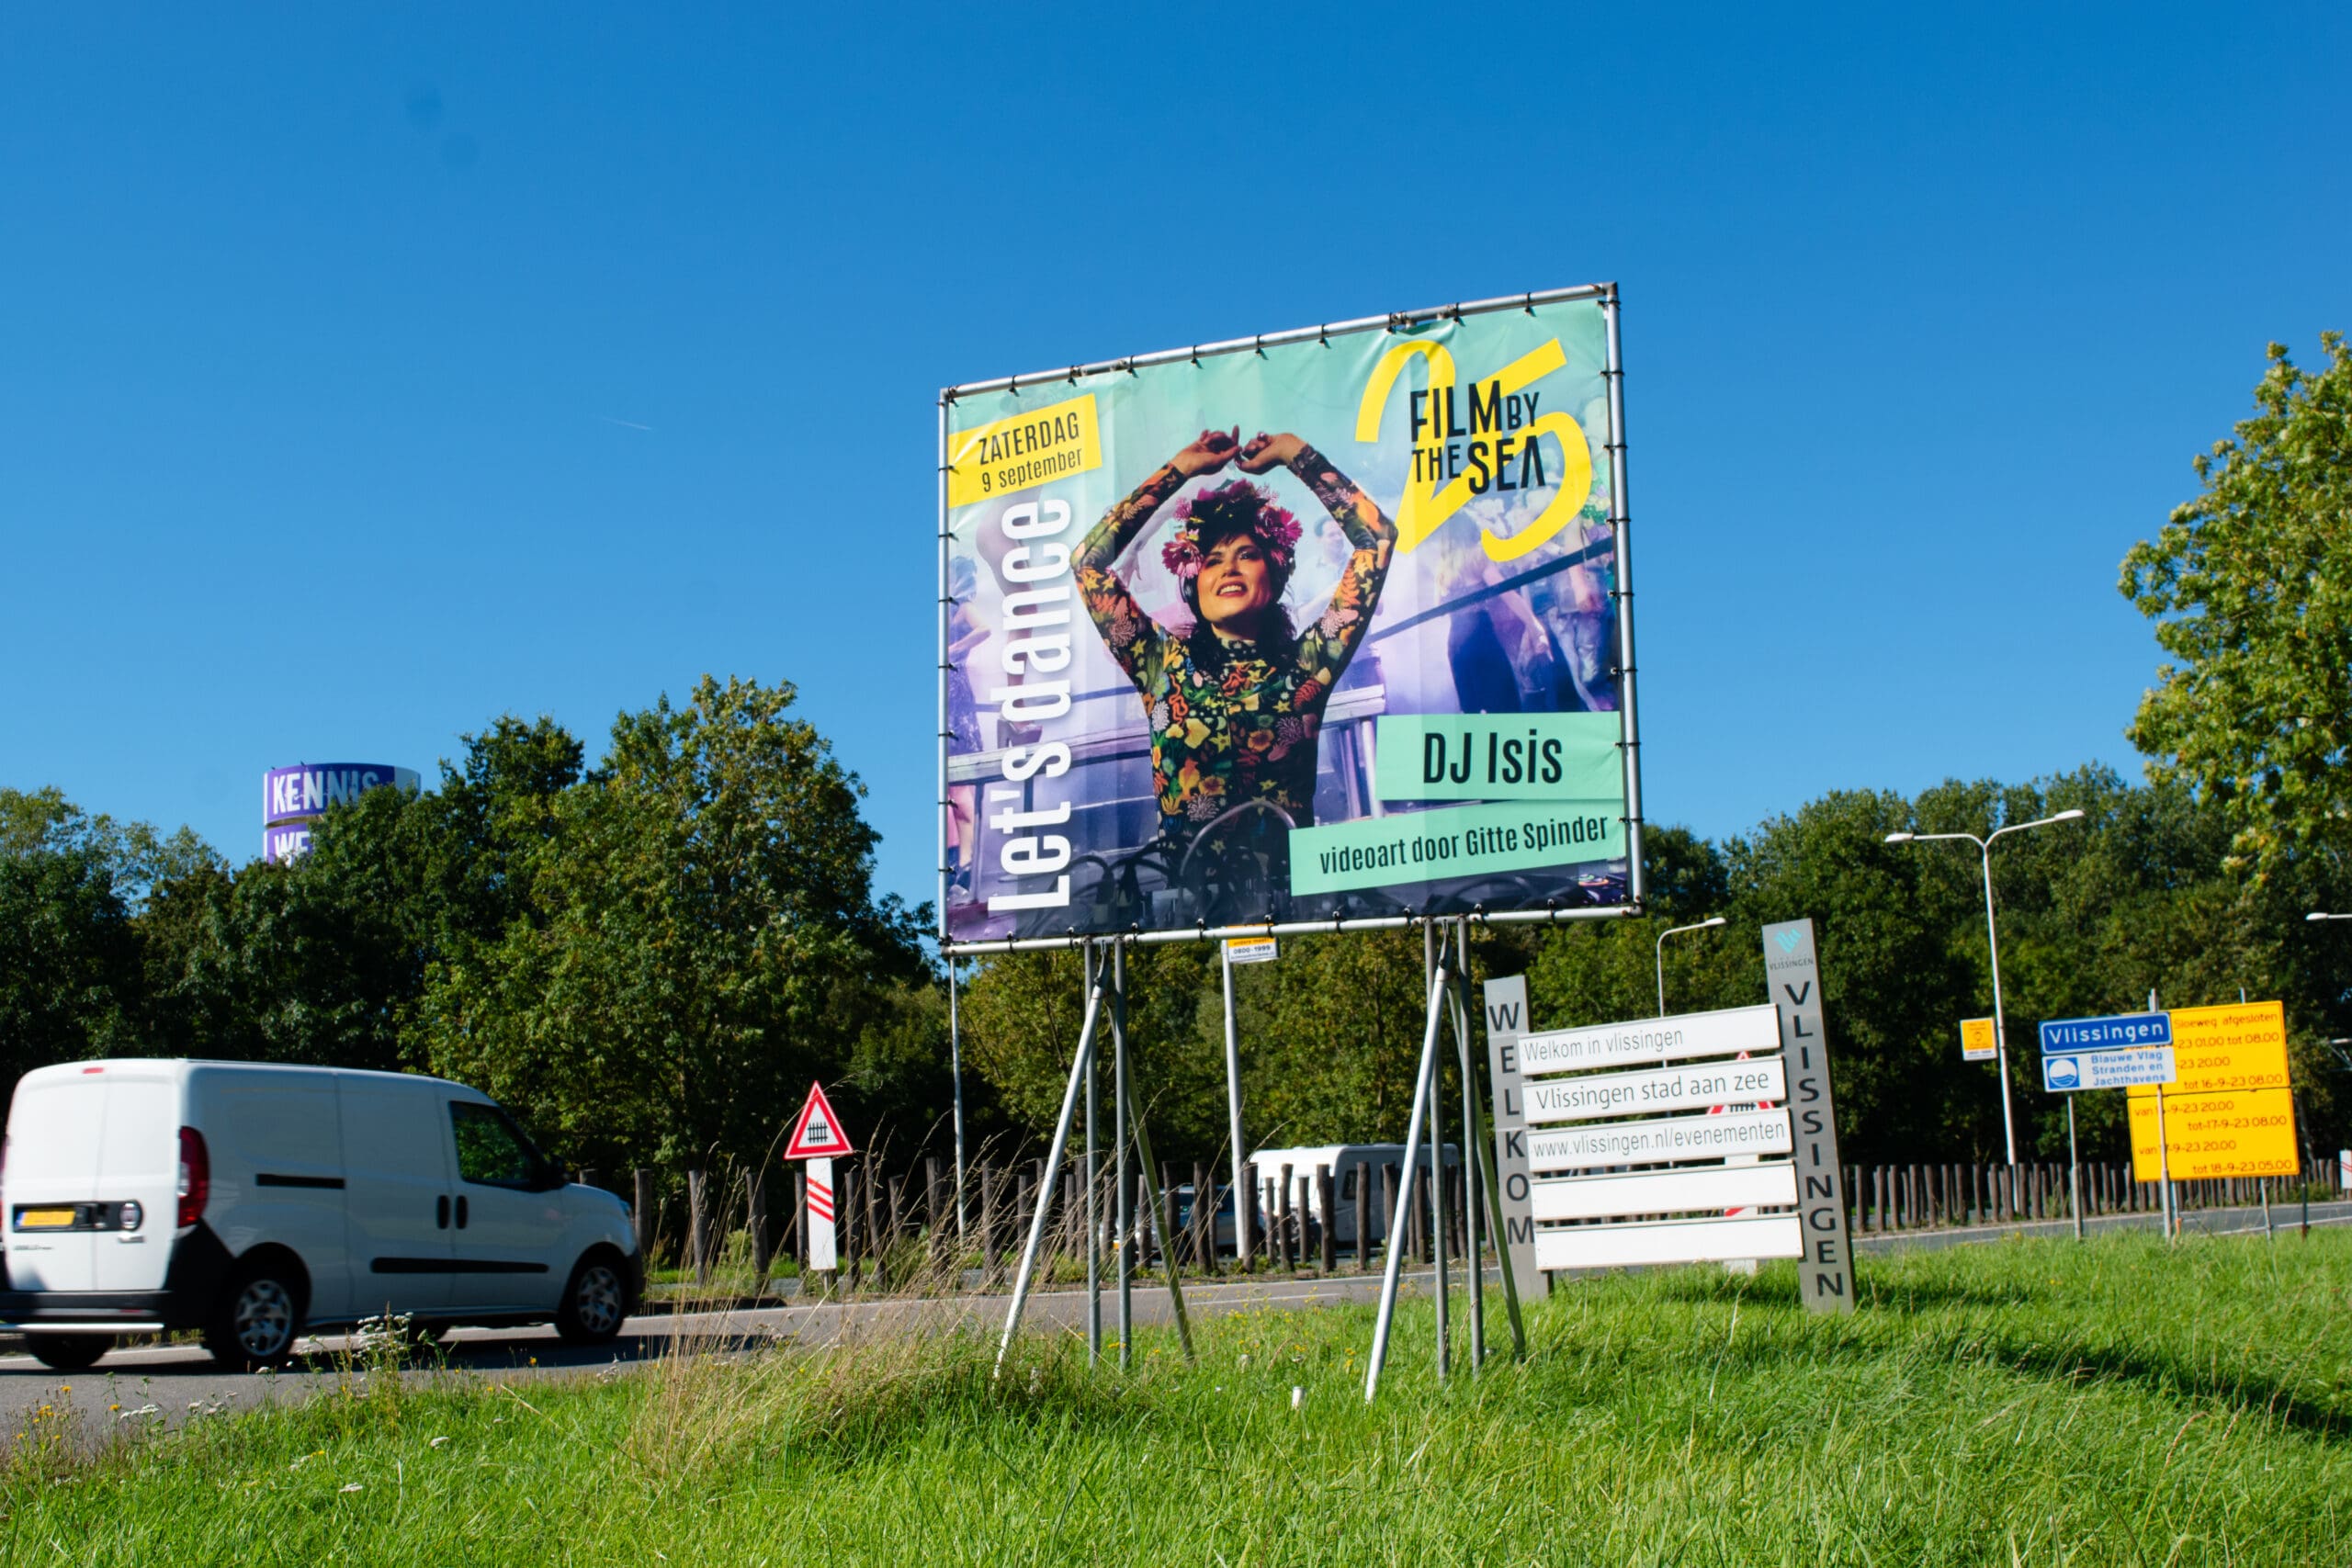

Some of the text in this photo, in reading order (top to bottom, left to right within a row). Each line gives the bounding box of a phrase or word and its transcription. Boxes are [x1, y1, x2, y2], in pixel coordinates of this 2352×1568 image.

[1410, 380, 1540, 442] FILM BY
[978, 412, 1080, 466] ZATERDAG
[1355, 339, 1592, 562] 25
[982, 448, 1082, 492] 9 september
[1412, 435, 1546, 495] THE SEA
[988, 497, 1071, 912] Let's dance
[1424, 729, 1563, 784] DJ Isis
[1320, 816, 1608, 874] videoart door Gitte Spinder
[2048, 1022, 2164, 1044] Vlissingen
[2222, 1012, 2278, 1027] afgesloten
[1524, 1029, 1684, 1062] Welkom in vlissingen
[2195, 1036, 2224, 1047] 01.00
[2227, 1035, 2242, 1044] tot
[2245, 1032, 2279, 1043] 08.00
[2091, 1051, 2163, 1065] Blauwe Vlag
[2092, 1062, 2163, 1075] Stranden en
[2198, 1056, 2231, 1068] 20.00
[1536, 1072, 1770, 1110] Vlissingen stad aan zee
[2094, 1074, 2166, 1087] Jachthavens
[2184, 1073, 2283, 1089] tot 16-9-23 08.00
[1488, 1002, 1535, 1245] WELKOM
[2134, 1108, 2154, 1117] van
[2201, 1100, 2234, 1112] 20.00
[2252, 1115, 2287, 1127] 08.00
[1533, 1121, 1785, 1158] www.vlissingen.nl/evenementen
[1784, 980, 1844, 1297] VLISSINGEN
[2139, 1146, 2157, 1156] van
[2203, 1140, 2236, 1152] 20.00
[2193, 1164, 2207, 1174] tot
[2258, 1159, 2292, 1171] 05.00
